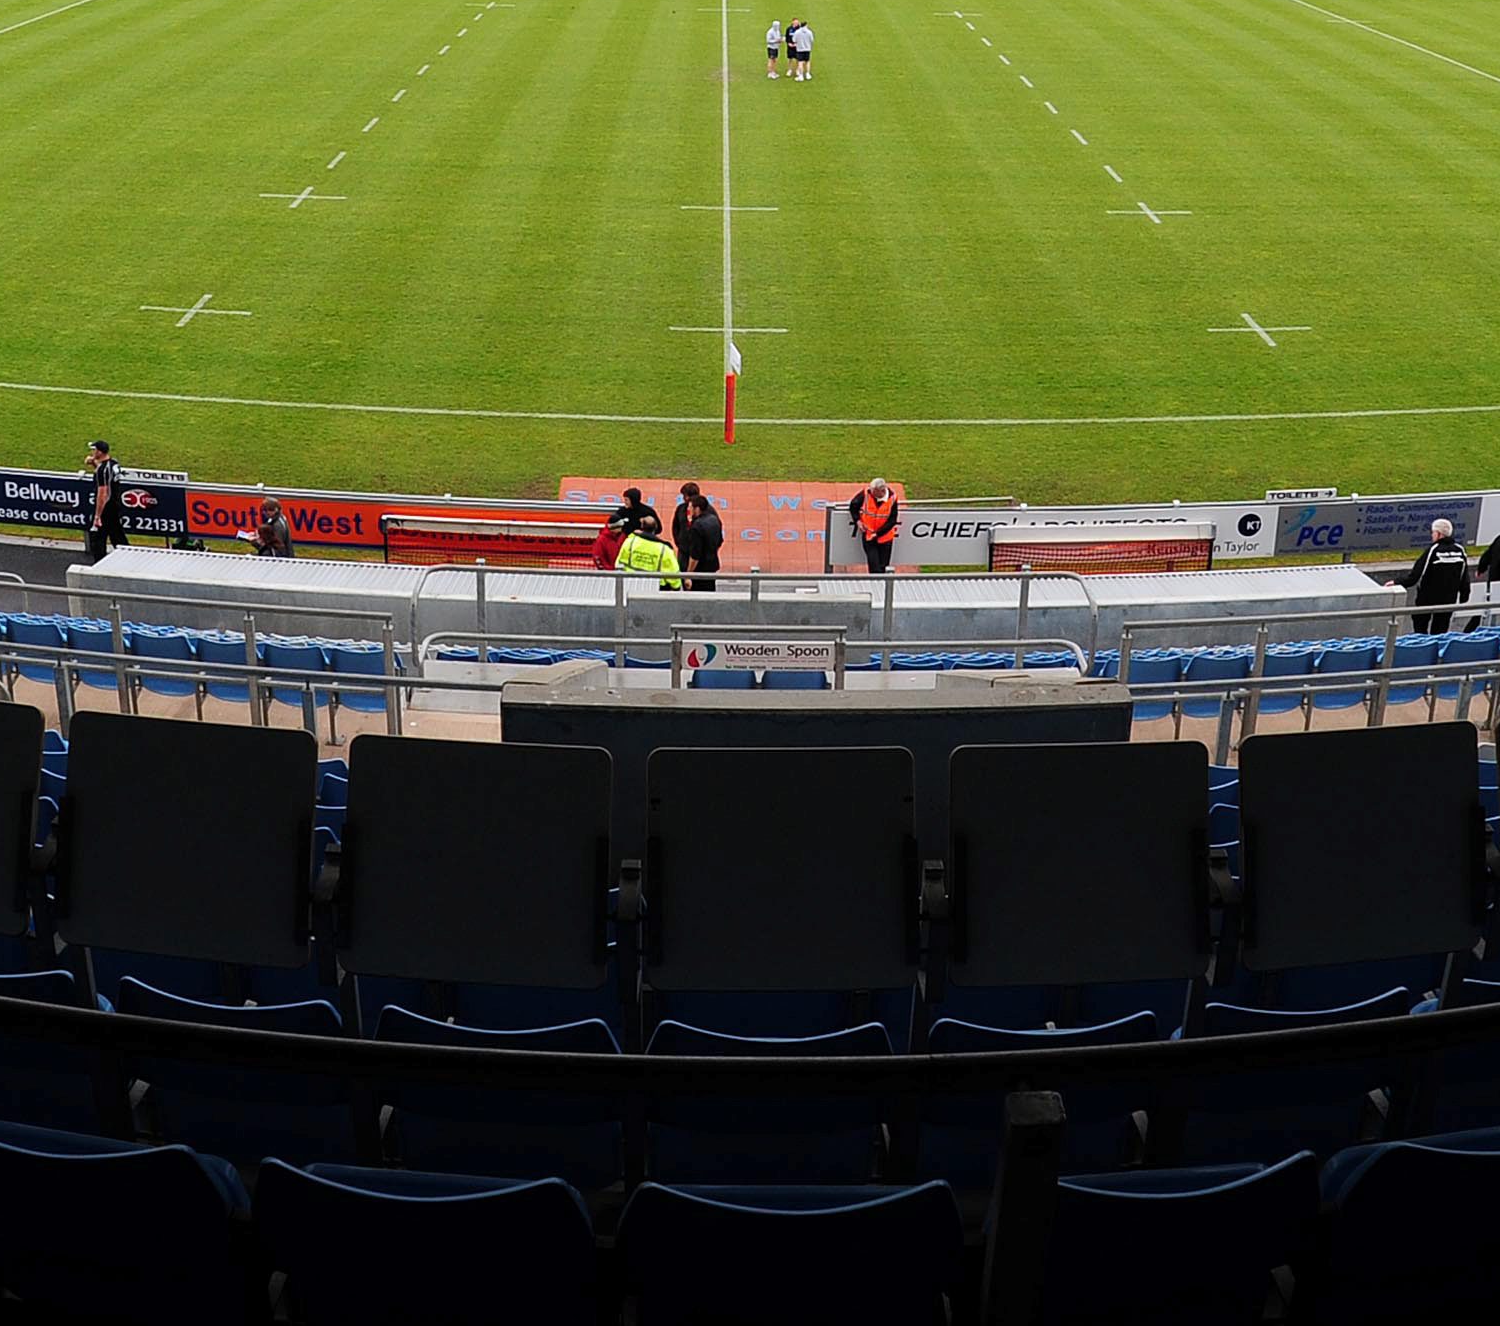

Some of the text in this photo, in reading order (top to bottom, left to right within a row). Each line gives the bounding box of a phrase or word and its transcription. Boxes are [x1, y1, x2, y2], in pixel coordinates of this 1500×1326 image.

[136, 471, 186, 482] TOILETS
[4, 481, 80, 508] Bellway
[1268, 490, 1320, 502] TOILETS
[1365, 501, 1475, 515] Radio Communications
[33, 510, 86, 525] contact
[135, 516, 185, 534] 221331
[289, 506, 363, 535] West
[1407, 512, 1458, 524] Navigation
[1246, 519, 1263, 532] KT
[1396, 524, 1418, 534] Free
[1225, 541, 1260, 554] Taylor
[724, 643, 830, 659] Wooden Spoon
